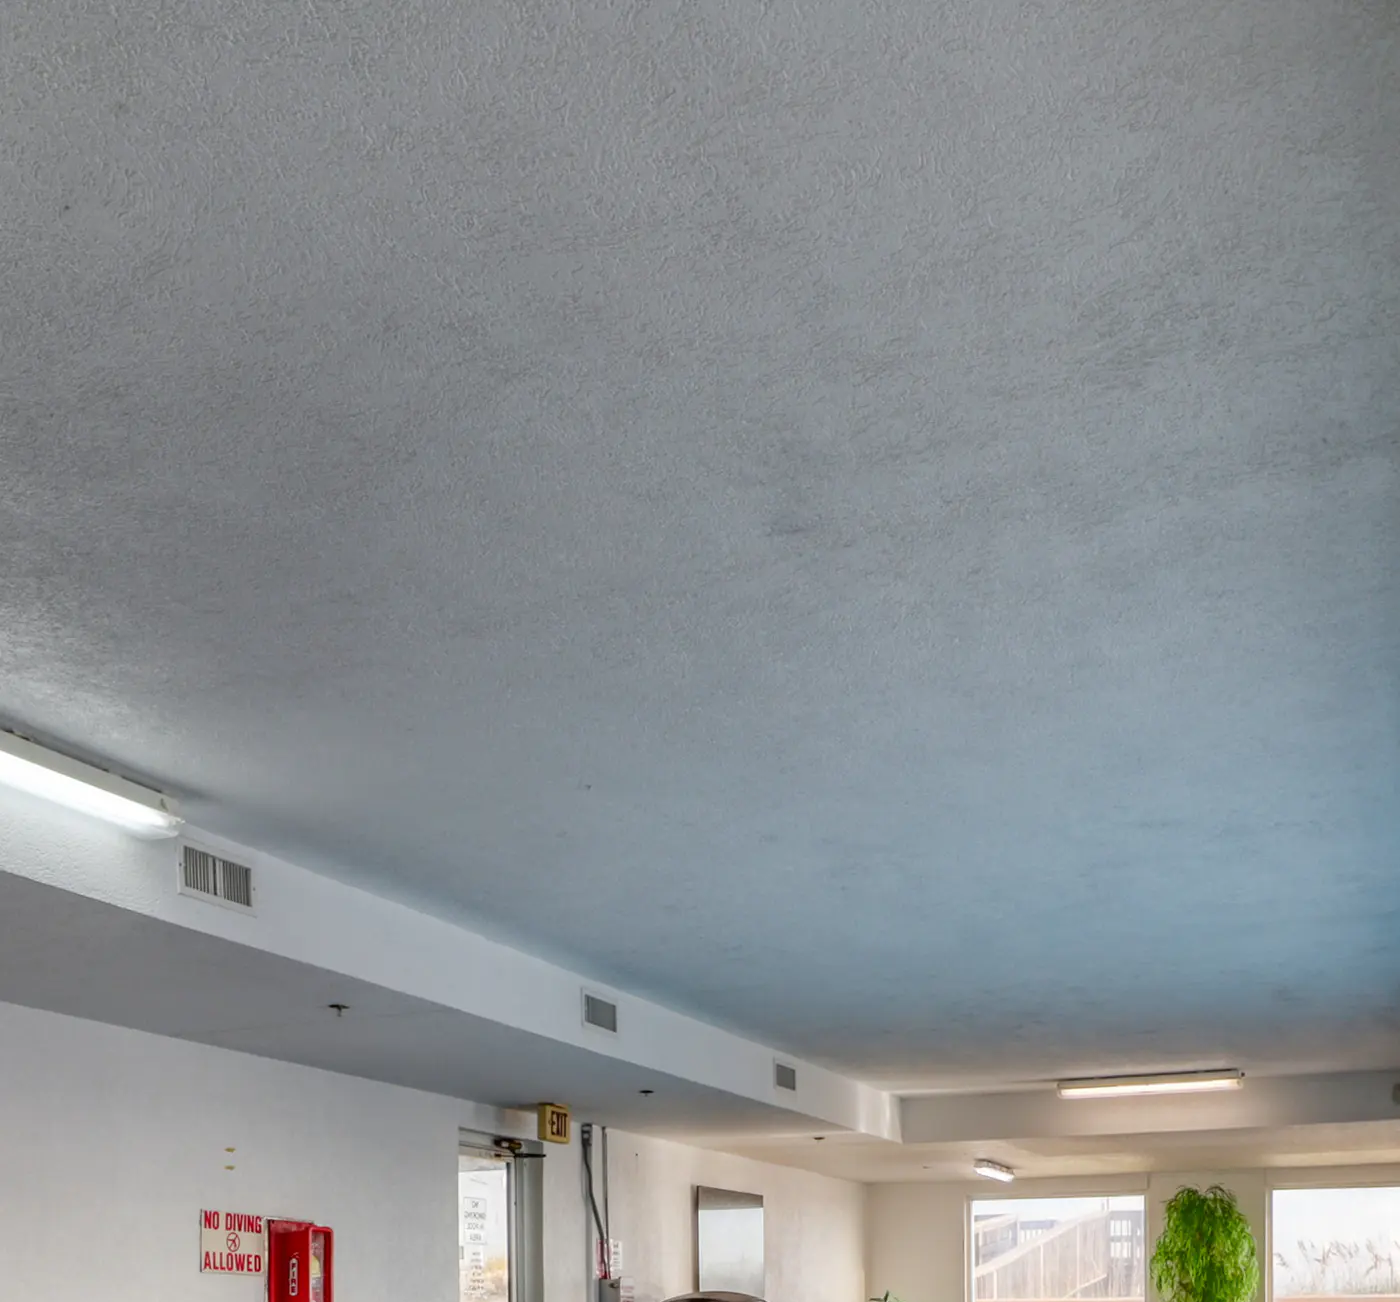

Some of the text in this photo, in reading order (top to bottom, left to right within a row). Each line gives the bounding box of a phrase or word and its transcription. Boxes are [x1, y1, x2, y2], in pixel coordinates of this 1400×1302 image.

[551, 1110, 567, 1138] EXIT
[204, 1210, 262, 1234] NO DIVING
[203, 1251, 262, 1272] ALLOWED
[290, 1262, 298, 1293] FIRE
